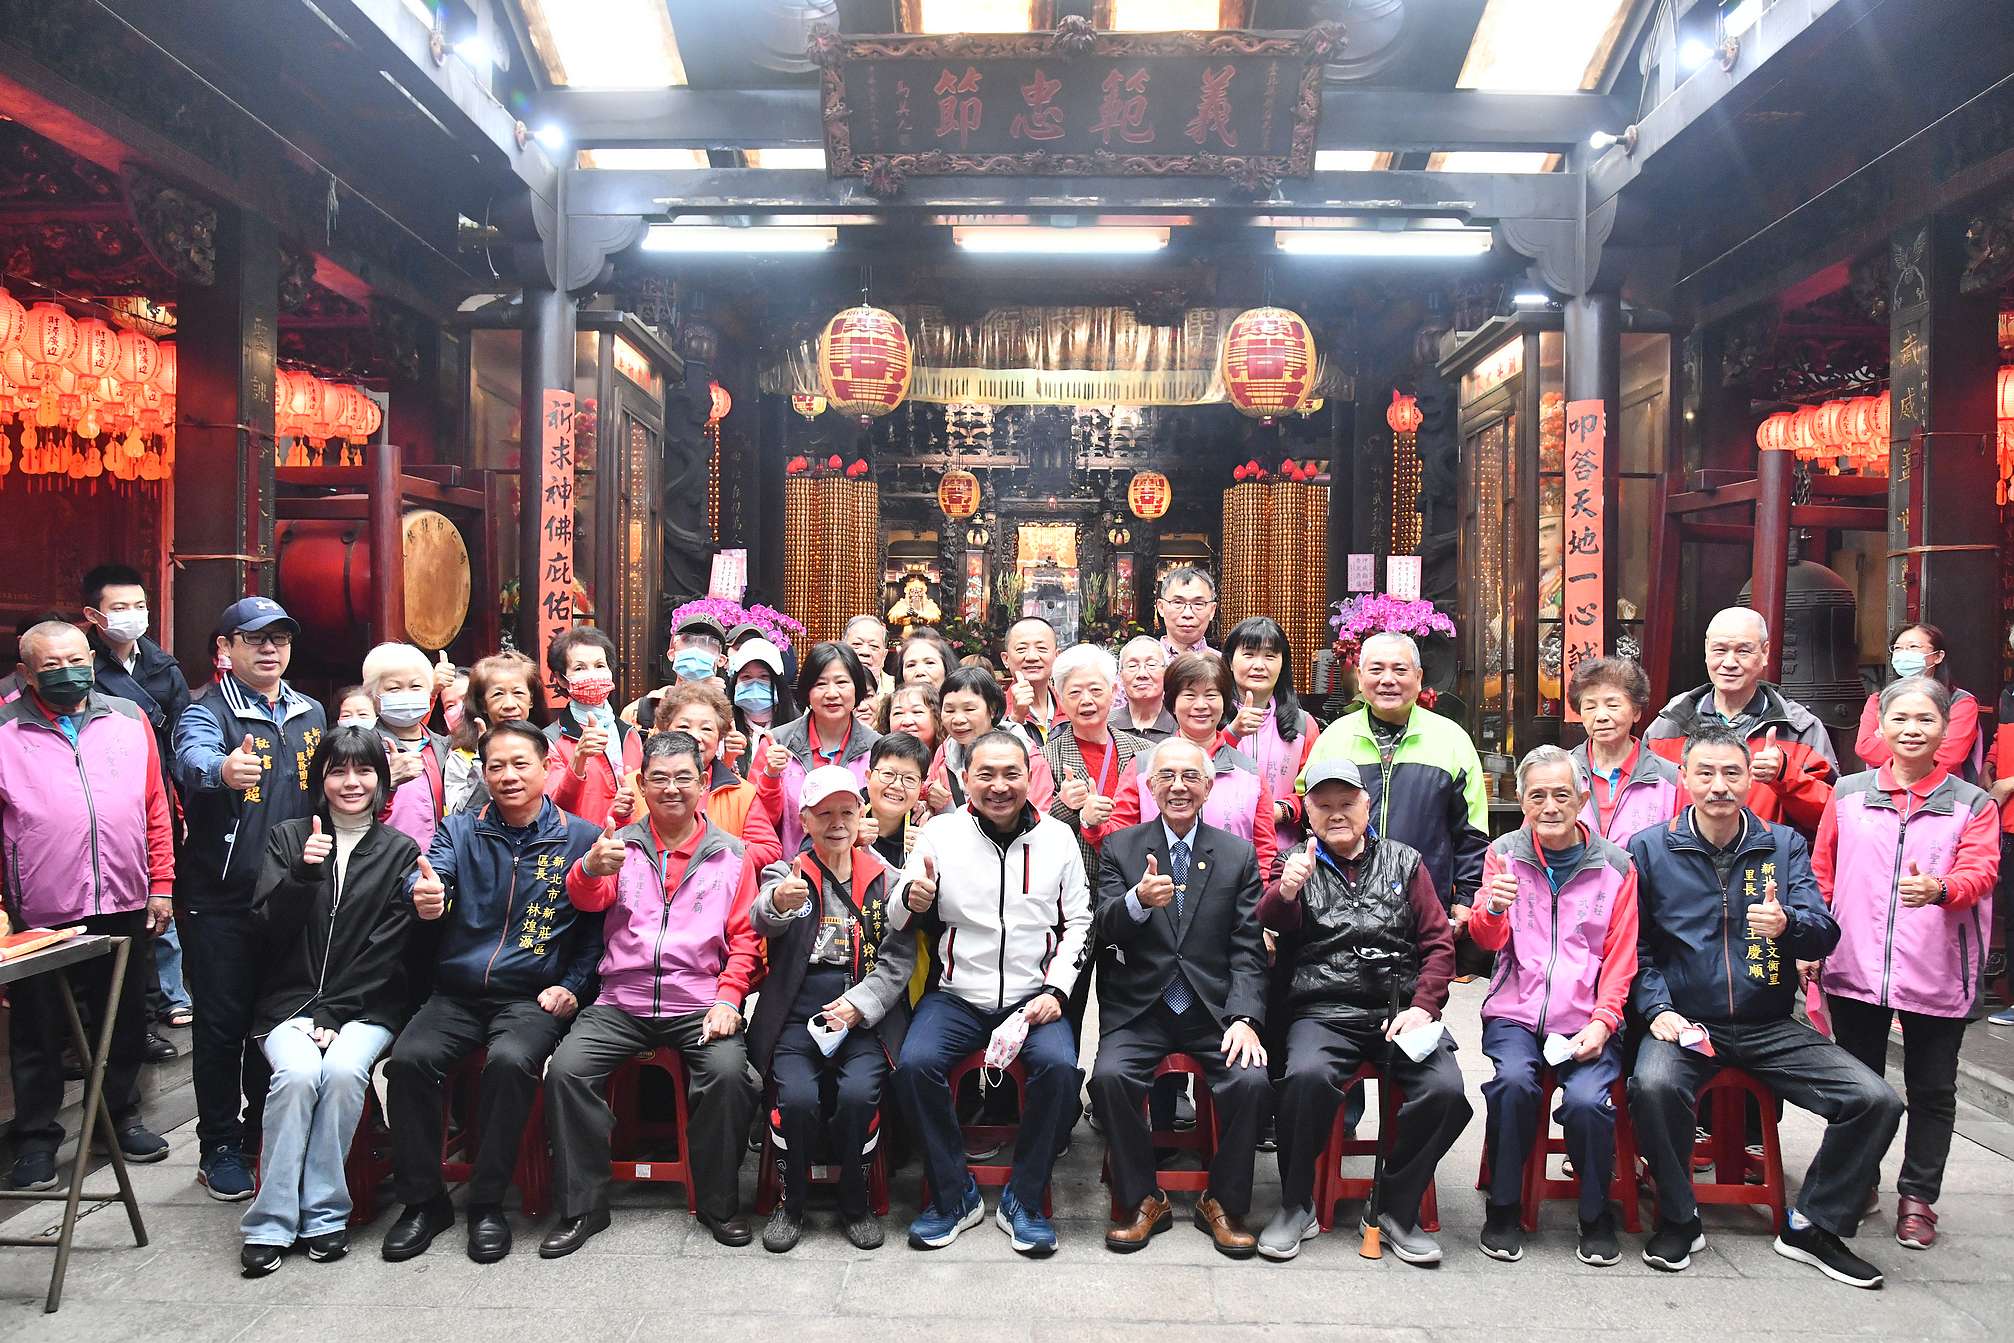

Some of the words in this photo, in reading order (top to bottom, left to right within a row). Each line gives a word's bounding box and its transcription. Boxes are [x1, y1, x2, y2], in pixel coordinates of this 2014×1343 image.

[535, 854, 549, 881] 區長
[1743, 869, 1758, 897] 里長
[519, 902, 542, 949] 林煌源
[533, 856, 566, 955] 新北市新莊區
[1744, 927, 1765, 979] 王慶順
